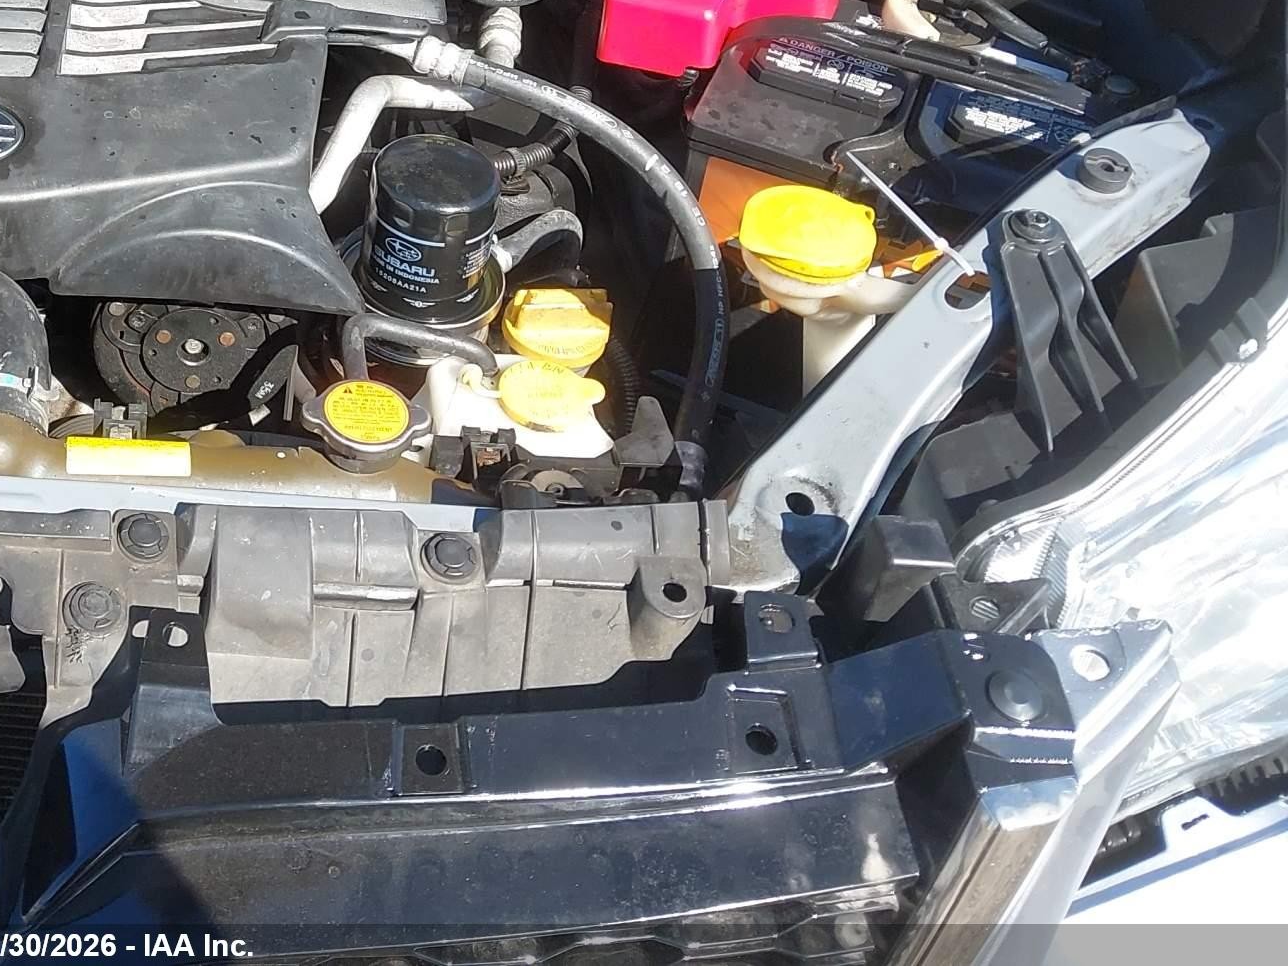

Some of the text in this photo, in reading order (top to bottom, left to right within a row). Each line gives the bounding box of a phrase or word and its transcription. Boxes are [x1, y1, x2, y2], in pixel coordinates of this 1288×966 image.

[790, 39, 836, 57] DANGER
[846, 55, 889, 72] POISON
[374, 244, 436, 277] SUBARU
[386, 263, 394, 272] IN
[394, 268, 440, 284] INDONESIA
